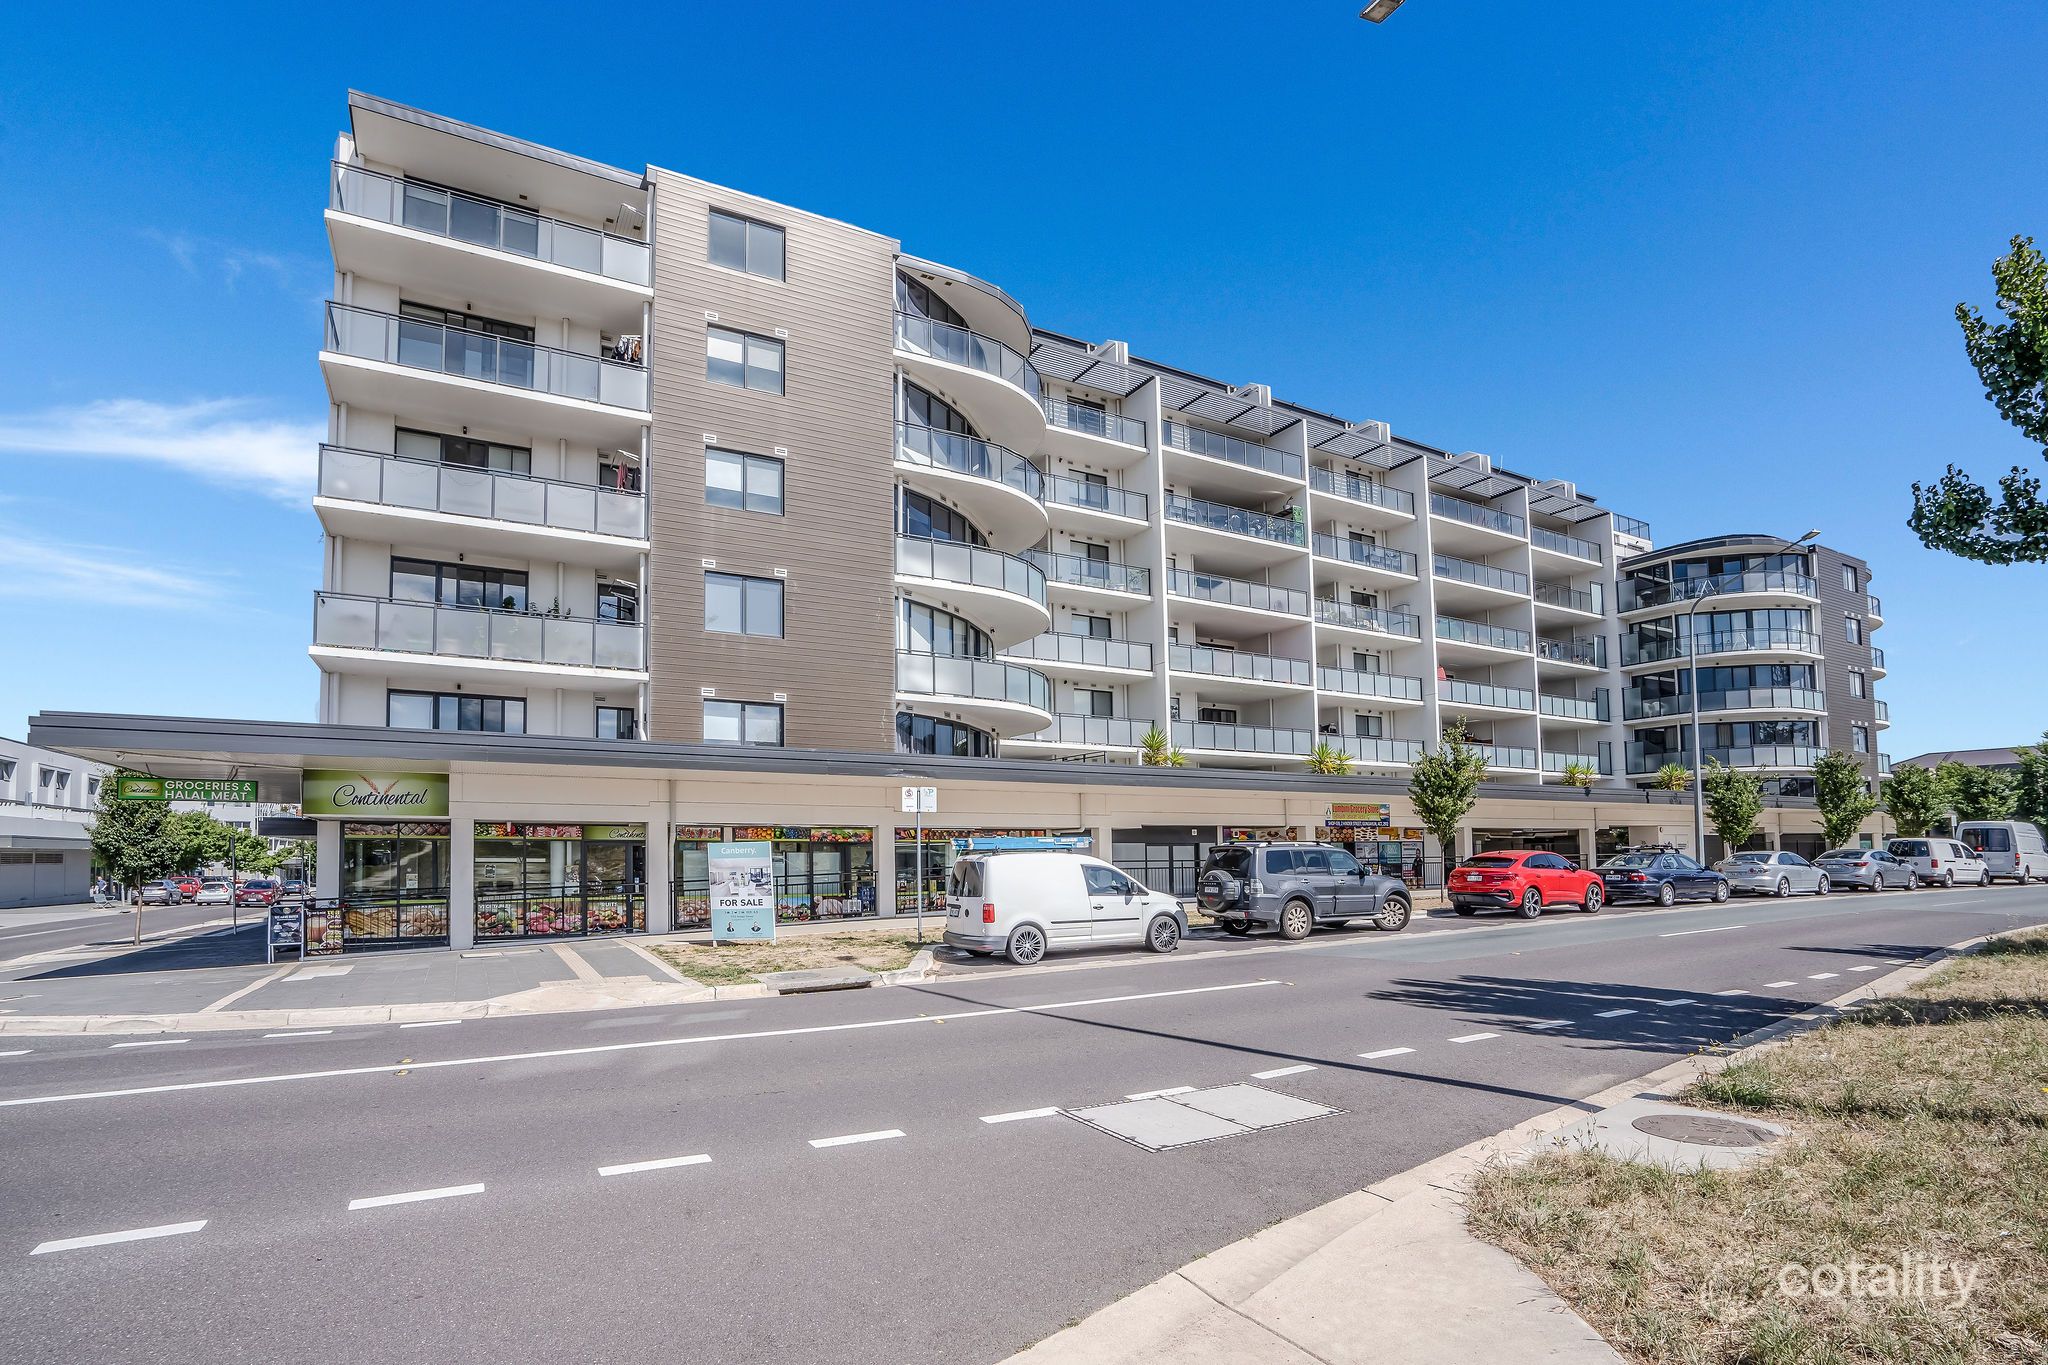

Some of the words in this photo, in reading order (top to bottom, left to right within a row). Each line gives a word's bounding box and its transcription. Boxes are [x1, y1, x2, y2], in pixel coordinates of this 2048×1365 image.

[164, 780, 239, 791] GROCERIES
[243, 783, 252, 791] &
[164, 790, 208, 800] HALAL
[211, 791, 248, 801] MEAT
[332, 784, 428, 807] Continental
[720, 899, 738, 907] FOR
[740, 899, 763, 907] SALE
